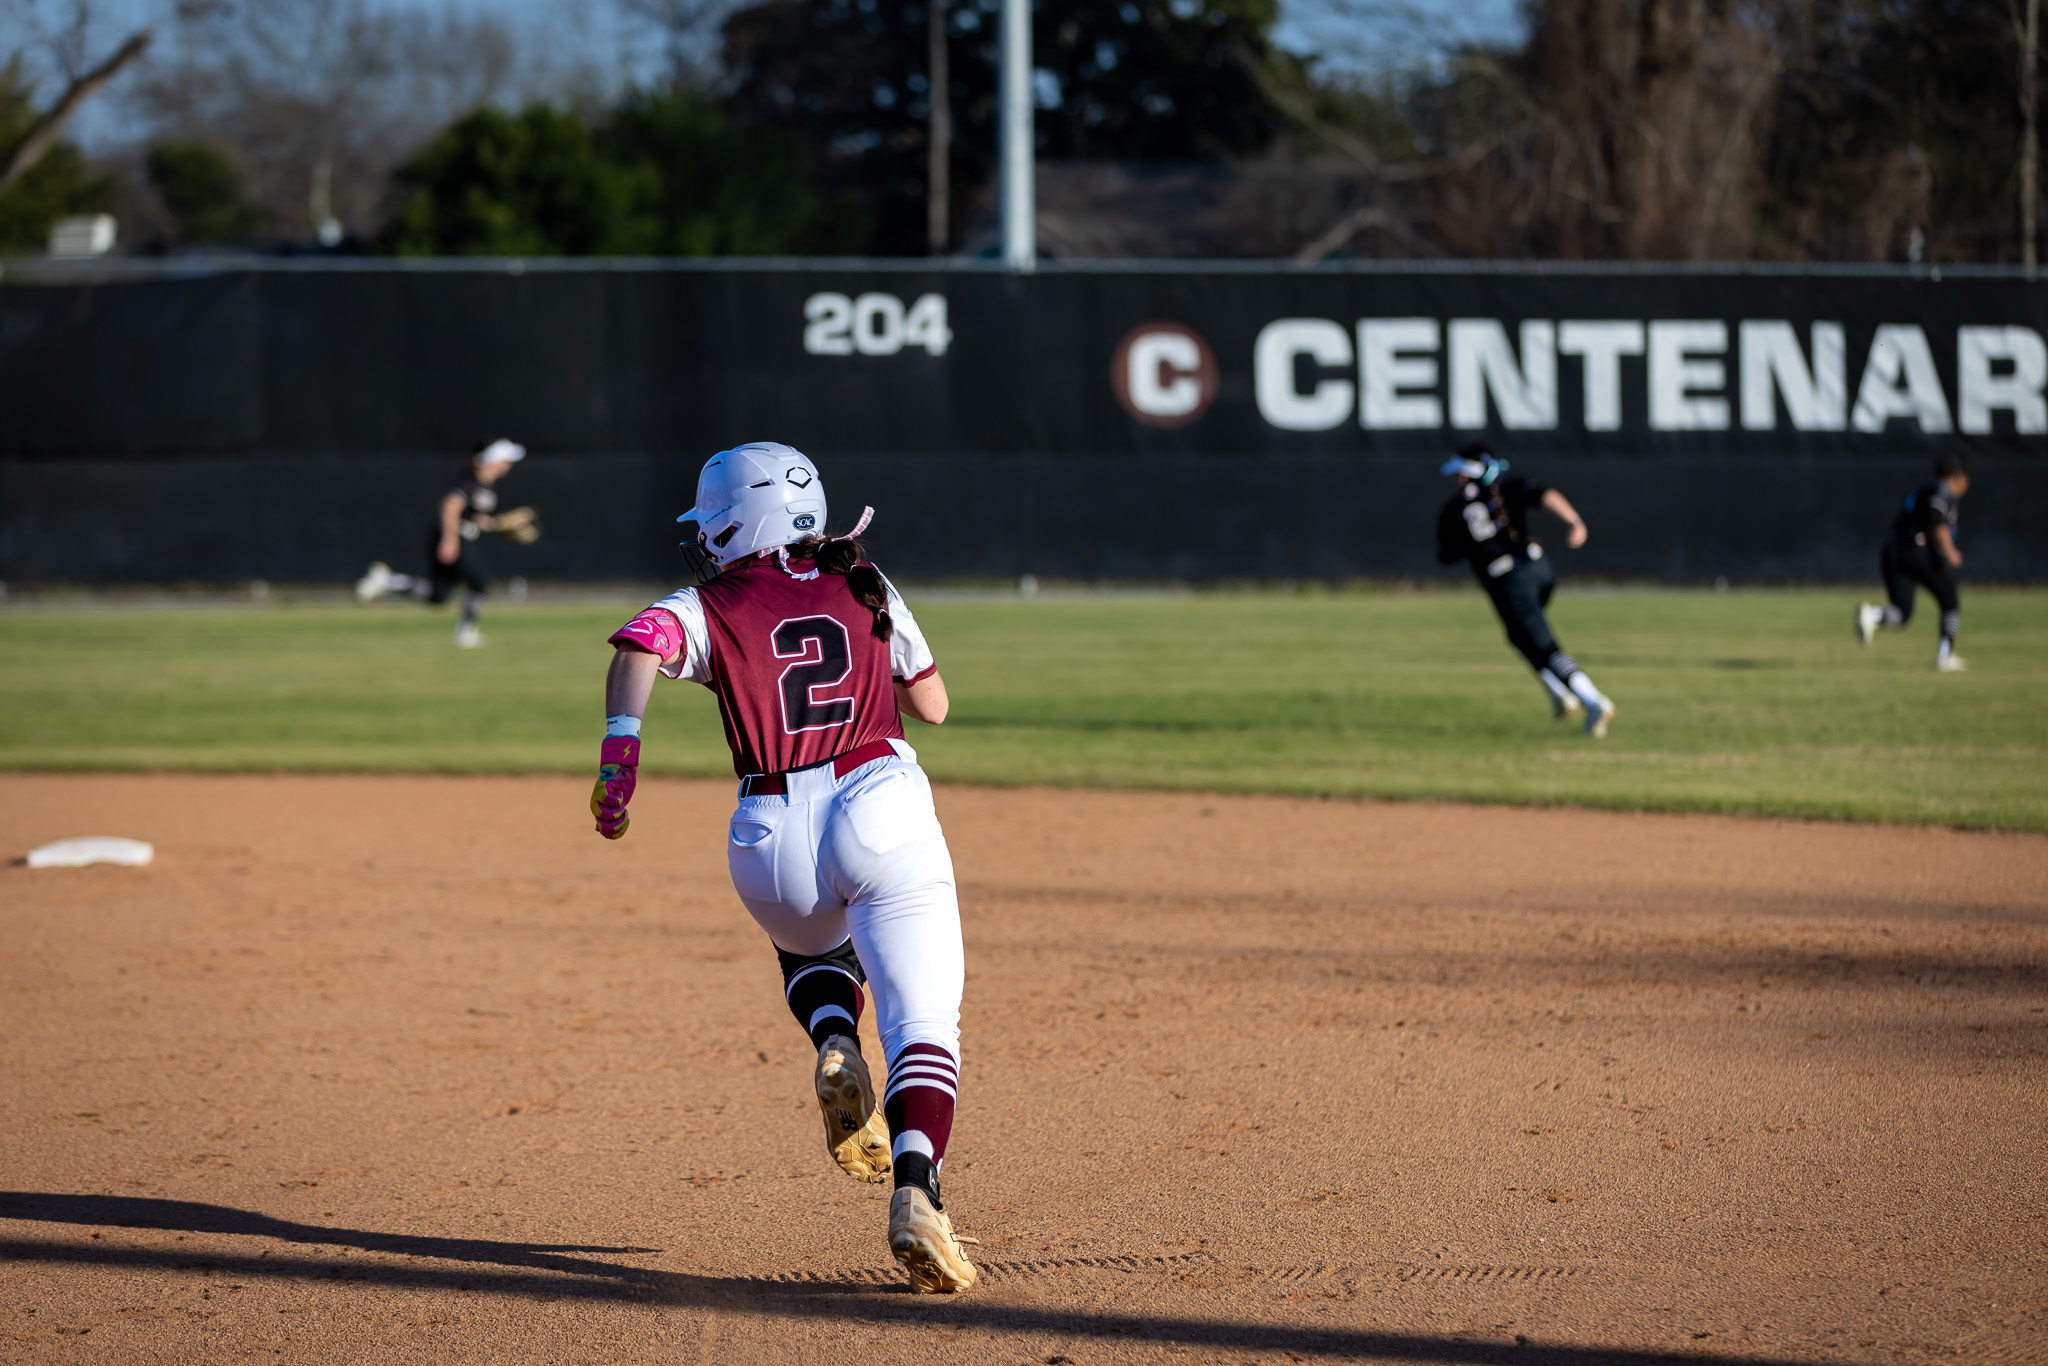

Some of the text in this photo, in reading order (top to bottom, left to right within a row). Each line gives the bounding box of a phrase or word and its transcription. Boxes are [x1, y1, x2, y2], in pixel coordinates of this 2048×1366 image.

[803, 291, 953, 356] 204
[1127, 317, 2048, 435] C CENTENAR
[771, 615, 854, 734] 2
